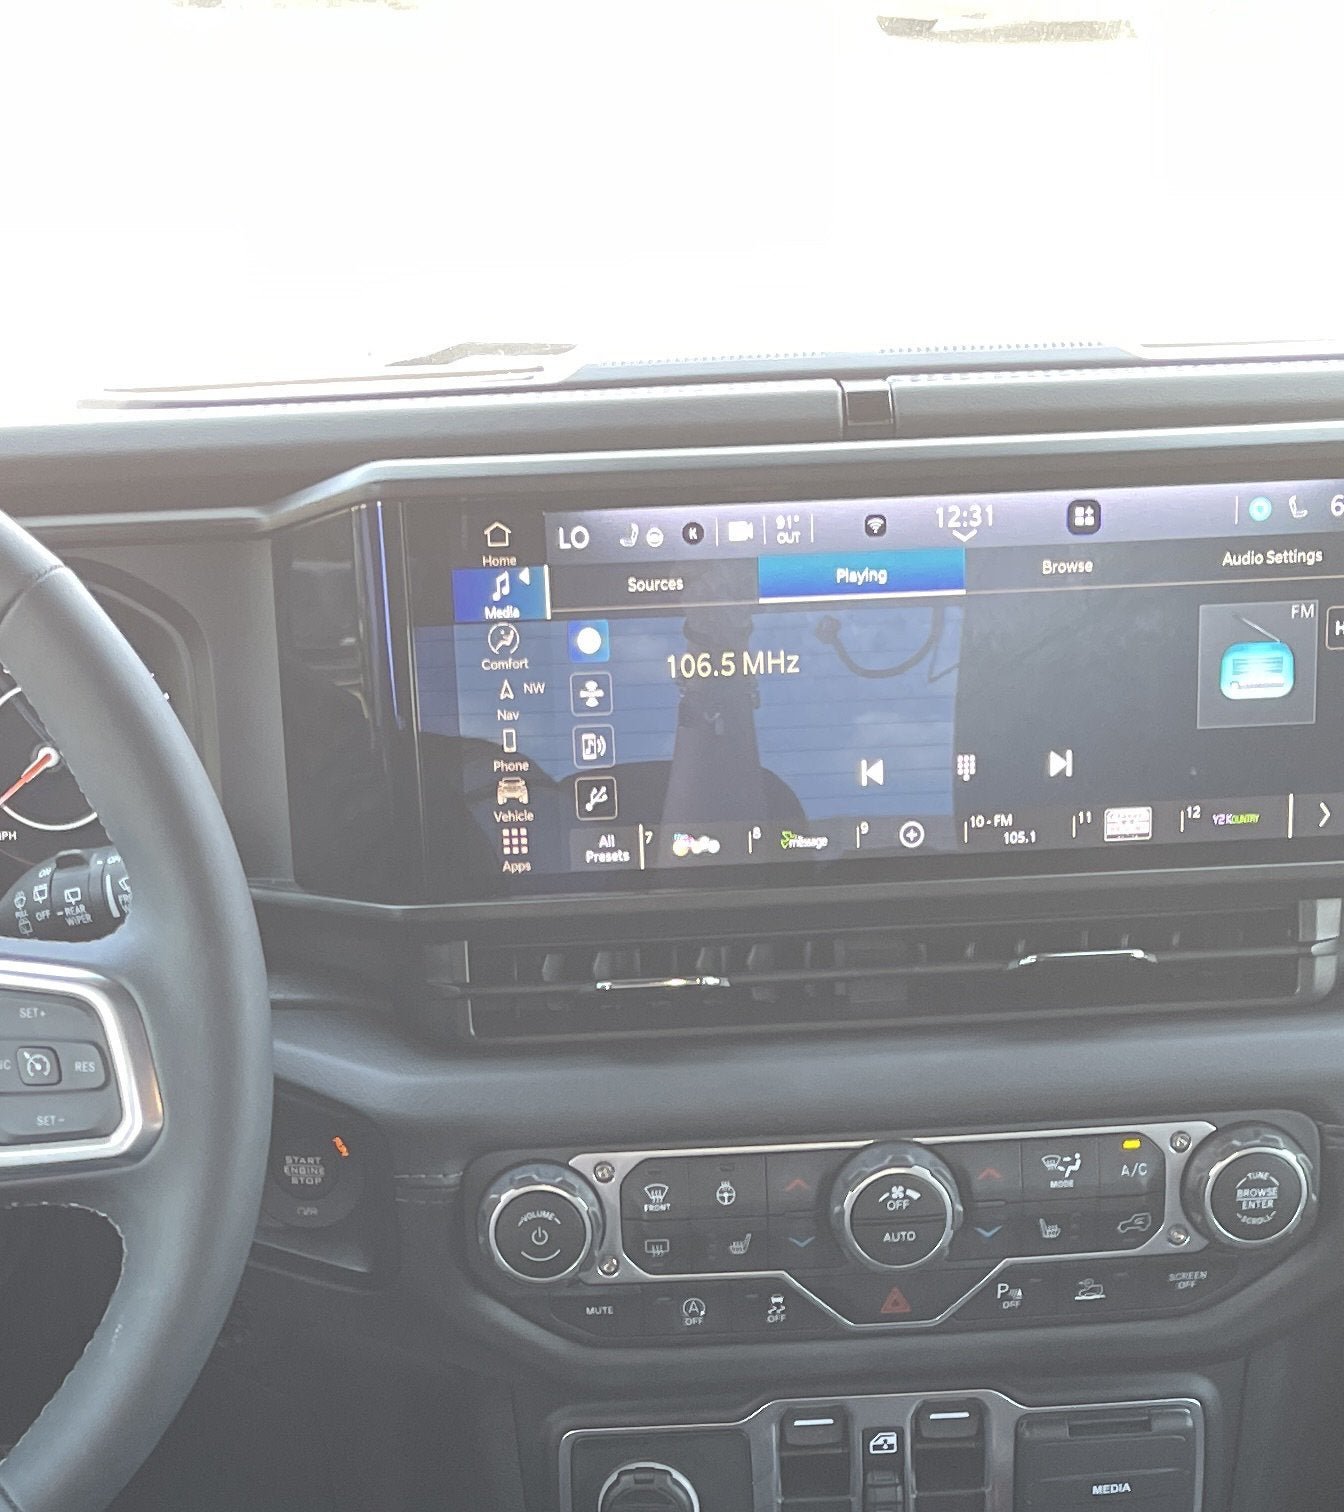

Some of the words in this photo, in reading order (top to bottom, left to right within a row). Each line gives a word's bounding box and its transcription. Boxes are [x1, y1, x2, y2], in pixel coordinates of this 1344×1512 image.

[776, 514, 800, 529] 91°
[936, 505, 994, 529] 12:31
[558, 526, 590, 549] LO
[776, 531, 801, 544] OUT
[482, 555, 517, 567] Home
[1222, 551, 1263, 566] Audio
[1266, 548, 1323, 565] Settings
[1042, 559, 1094, 575] Browse
[836, 567, 888, 585] Playing
[627, 576, 685, 593] Sources
[484, 607, 520, 619] Media
[1291, 604, 1315, 619] FM
[481, 658, 529, 671] Comfort
[667, 652, 737, 679] 106.5
[742, 651, 800, 677] MHz
[523, 683, 545, 695] NW
[497, 709, 520, 721] Nav
[493, 760, 529, 772] Phone
[494, 809, 534, 822] Vehicle
[1187, 806, 1201, 820] 12
[860, 822, 869, 835] 9
[599, 835, 616, 849] All
[645, 832, 653, 844] 7
[586, 850, 630, 864] Presets
[502, 861, 532, 875] Apps
[36, 909, 51, 922] OFF
[64, 903, 87, 916] REAR
[65, 913, 93, 926] WIPER
[75, 1062, 95, 1073] RES
[285, 1155, 321, 1164] START
[284, 1165, 324, 1175] ENGINE
[1121, 1162, 1148, 1178] A/C
[291, 1177, 322, 1185] STOP
[1236, 1187, 1278, 1198] BROWSE
[887, 1200, 909, 1211] OFF
[1241, 1200, 1274, 1210] ENTER
[521, 1210, 555, 1221] VOLUME
[883, 1231, 916, 1243] AUTO
[1168, 1271, 1207, 1281] SCREEN
[1178, 1281, 1196, 1289] OFF
[586, 1306, 614, 1315] MUTE
[1002, 1301, 1021, 1309] OFF
[685, 1317, 703, 1326] OFF
[767, 1314, 786, 1323] OFF
[1092, 1483, 1130, 1495] MEDIA
